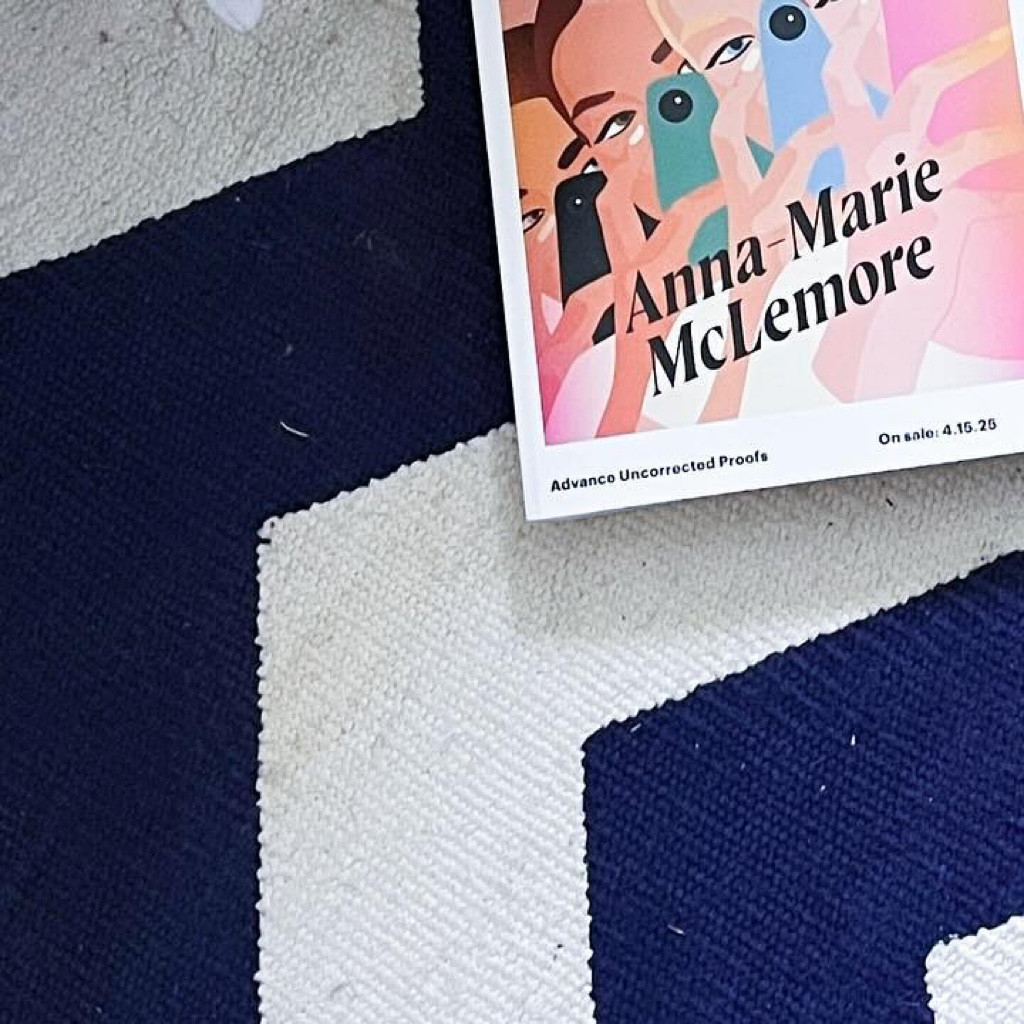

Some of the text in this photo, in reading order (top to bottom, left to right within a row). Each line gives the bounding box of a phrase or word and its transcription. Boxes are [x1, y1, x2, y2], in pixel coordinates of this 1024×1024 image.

[626, 153, 943, 332] Anna-Marie
[648, 235, 935, 396] McLemore
[551, 451, 768, 492] Advance Uncorrected Proofs
[879, 418, 997, 445] On sale: 4.15.25
